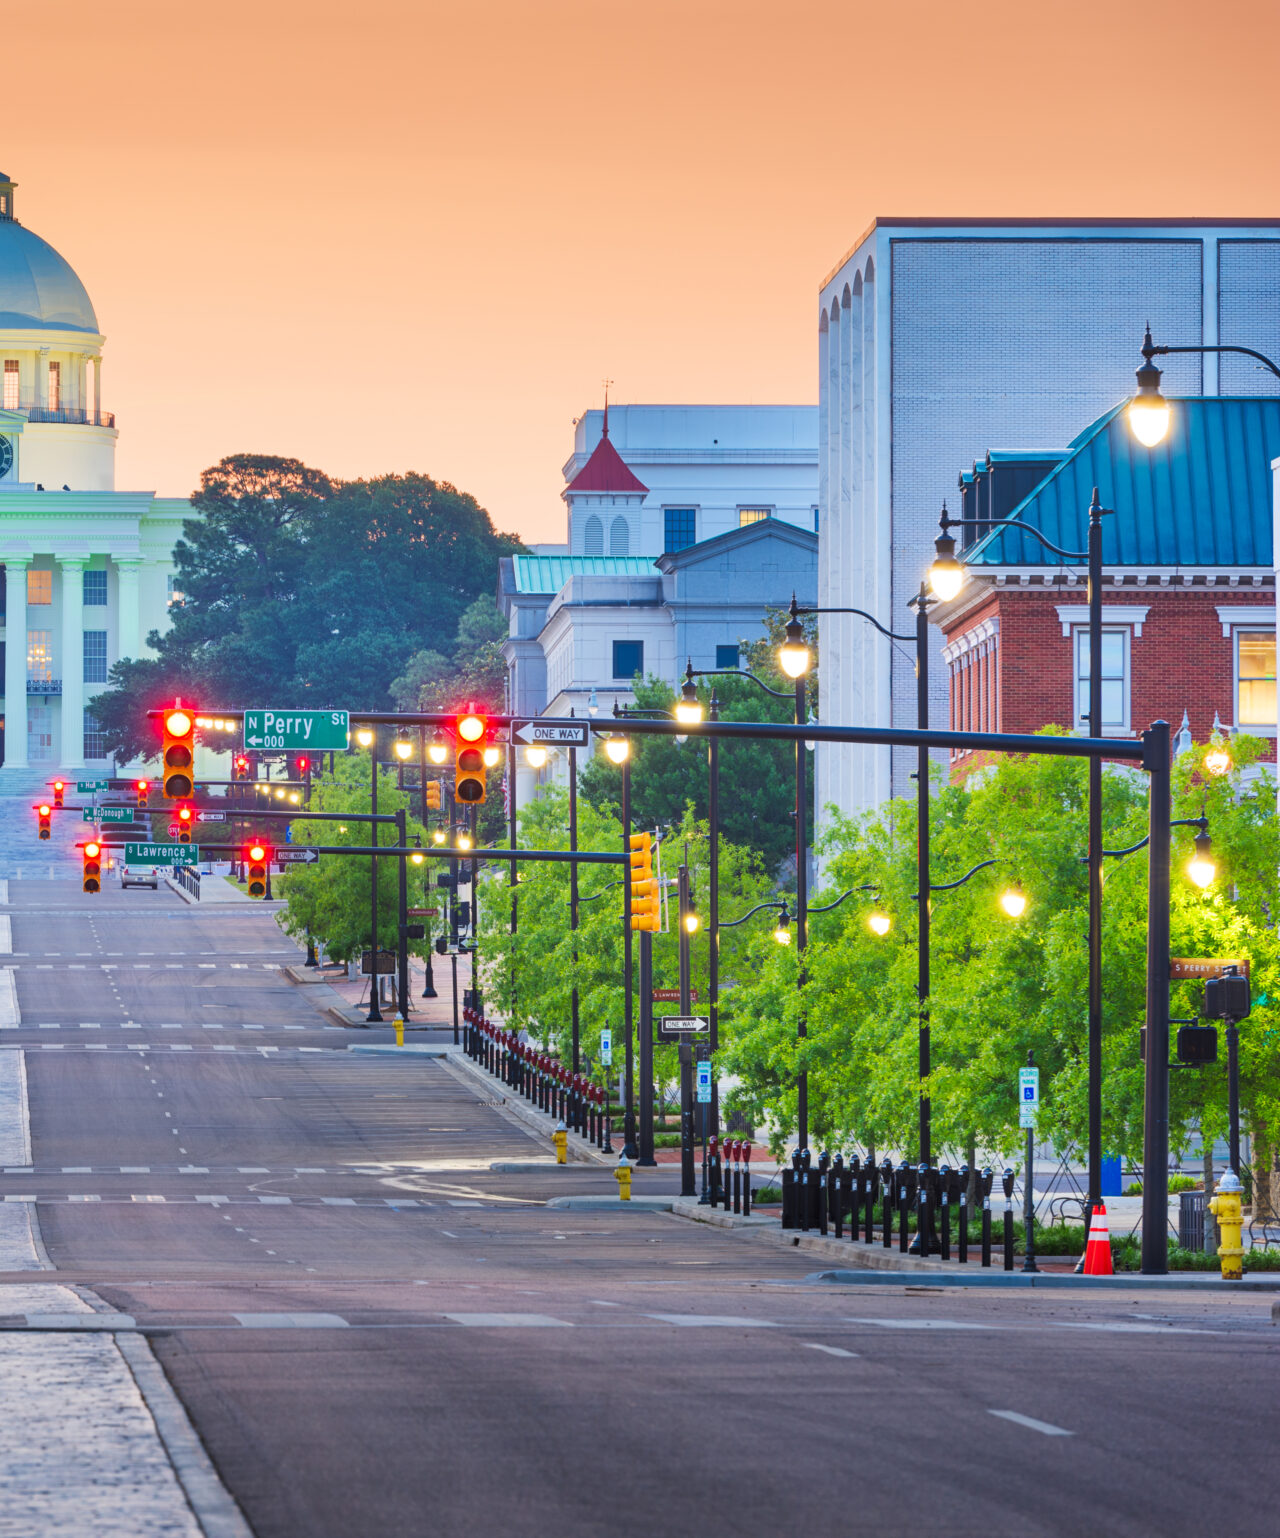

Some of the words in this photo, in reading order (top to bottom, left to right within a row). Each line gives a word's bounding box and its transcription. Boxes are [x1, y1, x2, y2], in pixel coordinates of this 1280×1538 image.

[248, 716, 257, 729] N
[264, 712, 313, 739] Perry
[331, 713, 345, 725] St
[534, 728, 555, 739] ONE
[558, 729, 580, 739] WAY
[264, 735, 285, 748] 000
[93, 807, 124, 819] McDonough
[128, 846, 133, 854] S
[137, 844, 186, 857] Lawrence
[189, 845, 196, 853] St
[170, 857, 184, 865] 000
[1175, 964, 1181, 972] S
[1184, 964, 1210, 972] PERRY
[1214, 965, 1247, 973] STET
